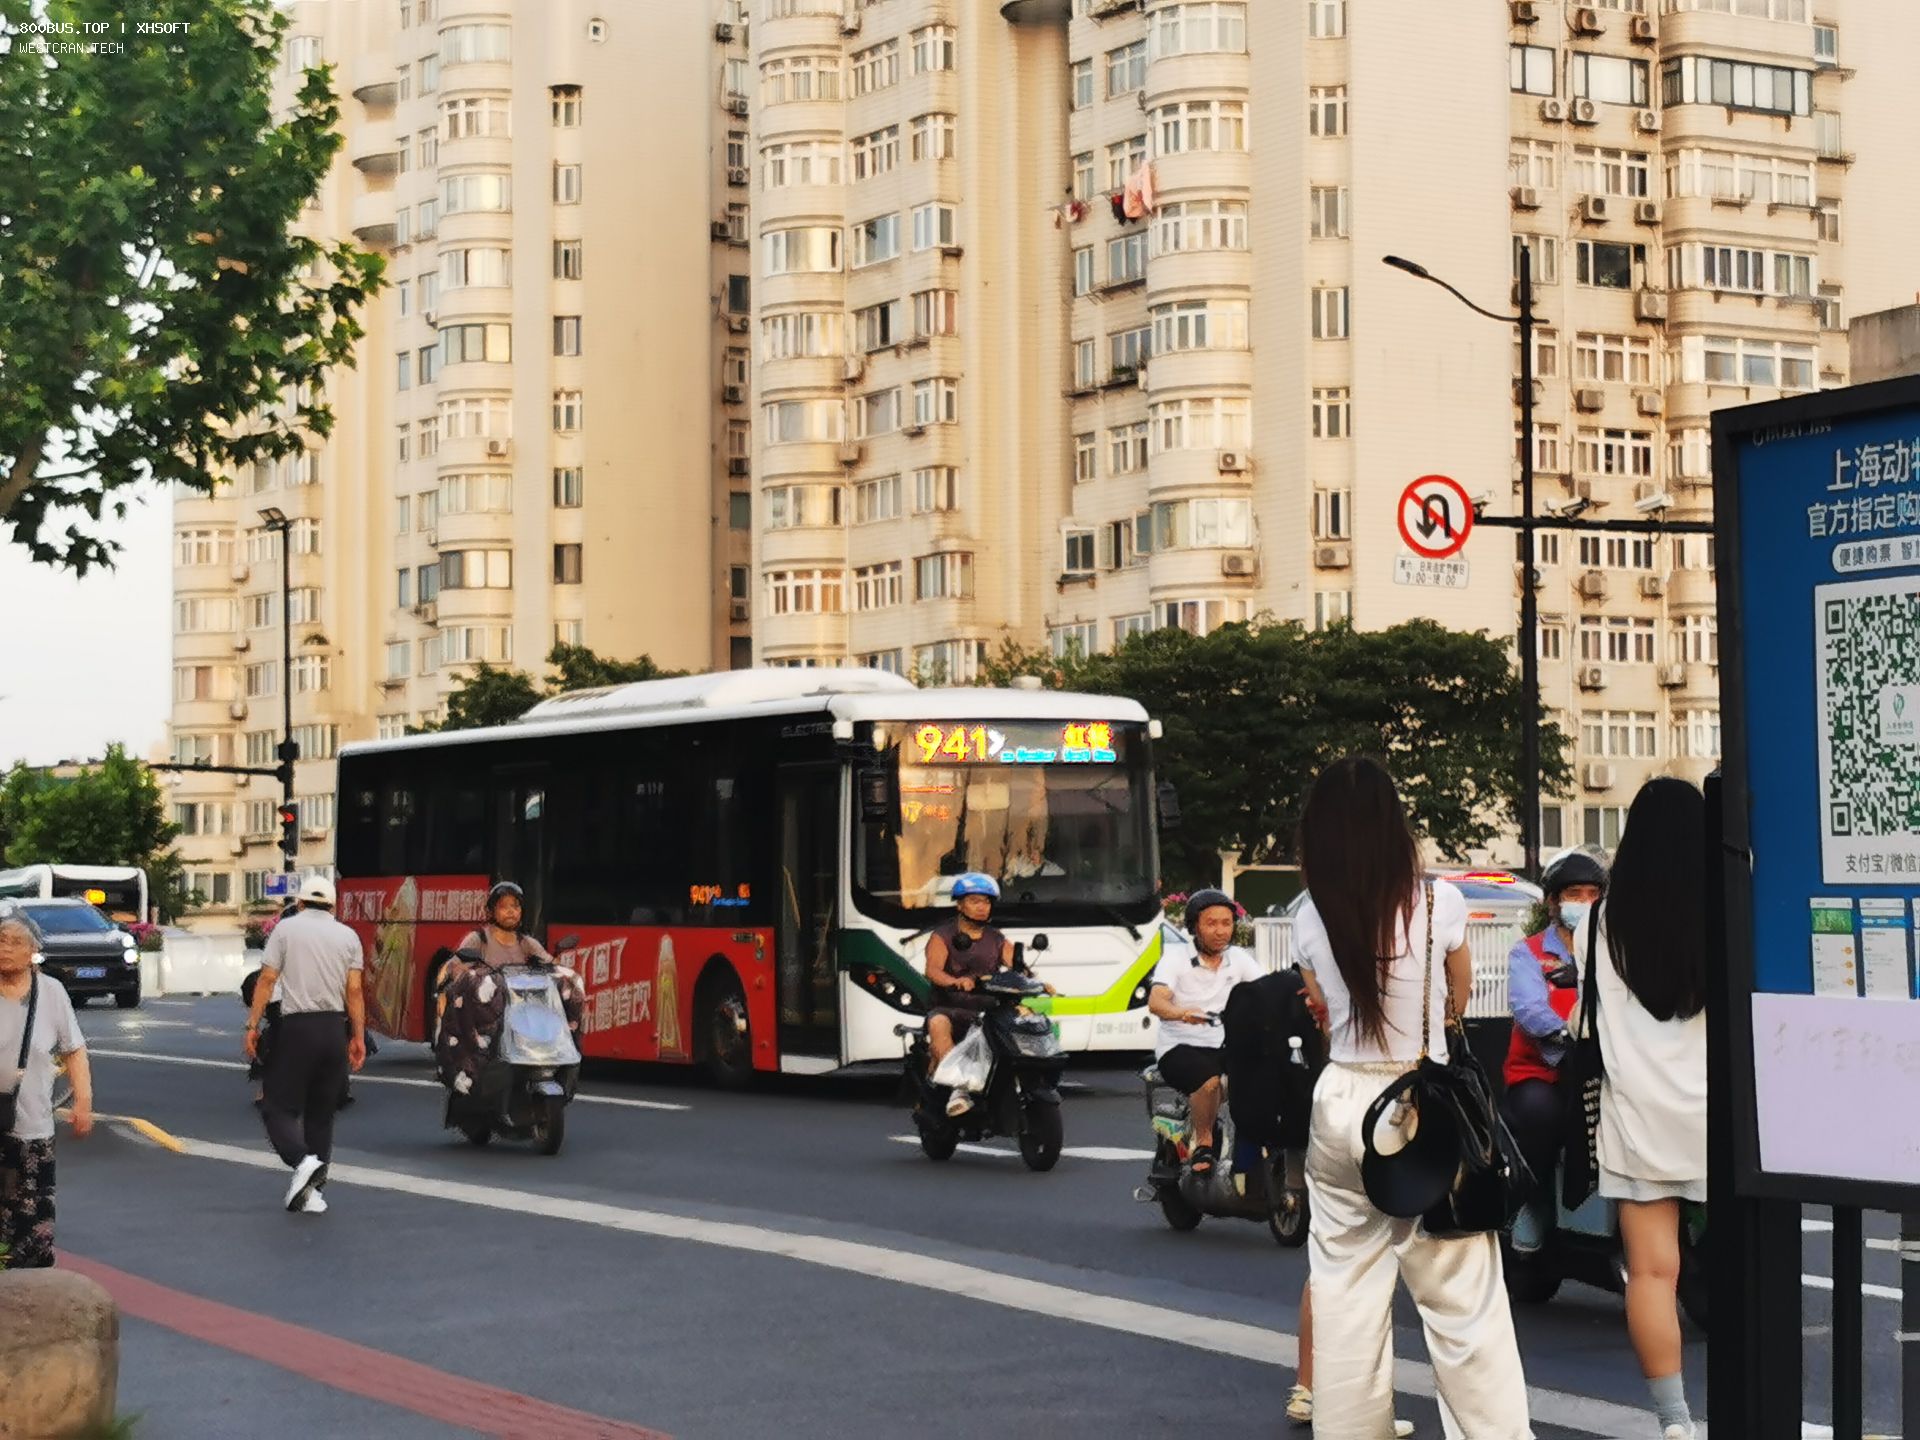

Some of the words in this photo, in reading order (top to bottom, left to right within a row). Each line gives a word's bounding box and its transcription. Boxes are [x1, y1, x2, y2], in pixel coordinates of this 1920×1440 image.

[1807, 491, 1920, 537] 官方指定购
[1839, 543, 1891, 567] 便捷购票
[1901, 539, 1920, 561] 智
[915, 723, 988, 763] 941
